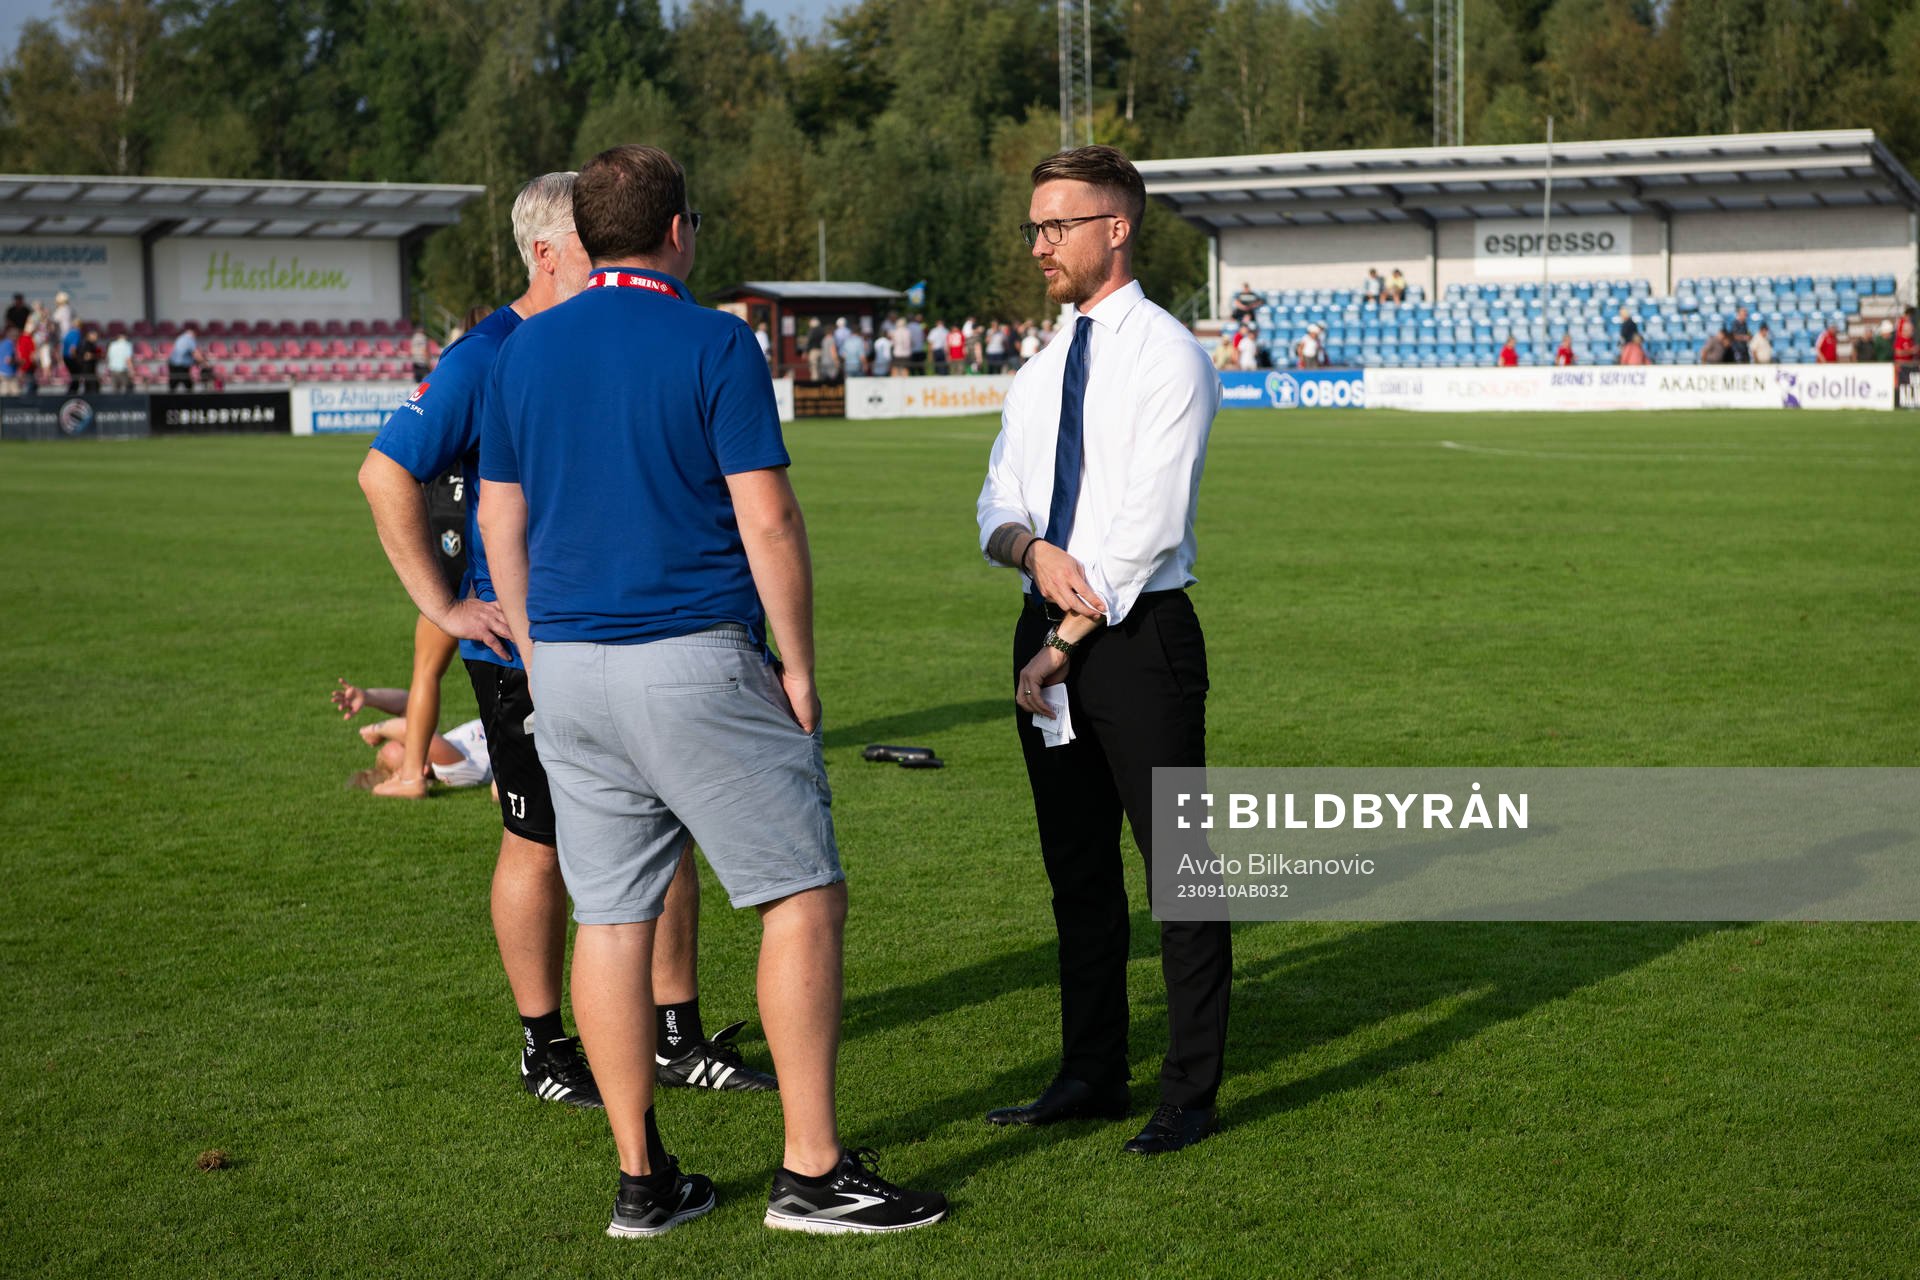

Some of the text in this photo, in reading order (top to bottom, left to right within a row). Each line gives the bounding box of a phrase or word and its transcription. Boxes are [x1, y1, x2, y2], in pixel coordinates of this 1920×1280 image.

[1485, 231, 1615, 257] espresso
[204, 250, 352, 293] Hässlehem
[1300, 379, 1363, 408] OBOS
[1659, 375, 1766, 393] AKADEMIEN
[1807, 375, 1871, 399] elolle
[179, 404, 275, 425] BILDBYRÅN
[317, 411, 382, 429] MASKIN
[410, 403, 425, 416] SPEL
[507, 791, 526, 819] TJ
[665, 1009, 679, 1035] CRAFT
